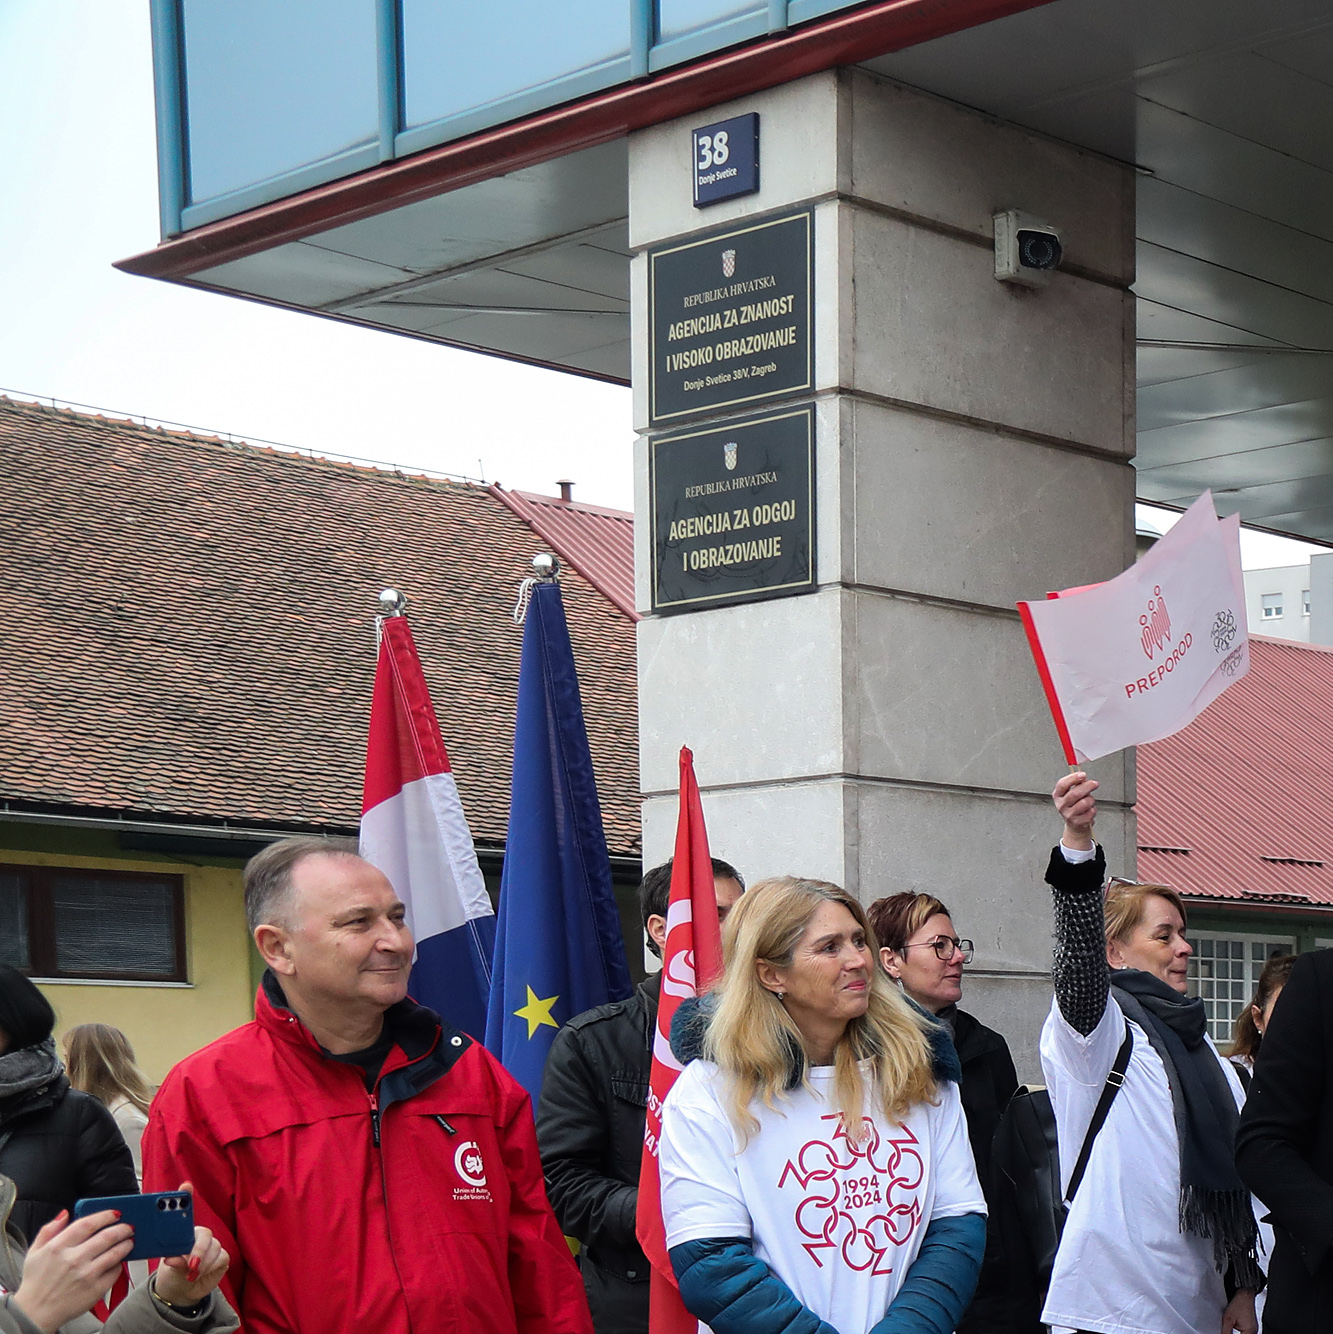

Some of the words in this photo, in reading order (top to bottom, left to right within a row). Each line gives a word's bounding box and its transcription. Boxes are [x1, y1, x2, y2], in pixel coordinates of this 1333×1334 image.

[698, 131, 729, 170] 38
[698, 173, 716, 185] Donje
[716, 168, 737, 180] Svetice
[684, 287, 729, 308] REPUBLIKA
[730, 275, 776, 296] HRVATSKA
[668, 312, 722, 341] AGENCIJA
[724, 309, 739, 328] ZA
[740, 295, 794, 324] ZNANOST
[666, 356, 670, 372] I
[672, 345, 713, 370] VISOKO
[716, 326, 796, 361] OBRAZOVANJE
[684, 378, 704, 391] Donje
[706, 373, 731, 387] Svetice
[732, 369, 750, 380] 38/V,
[751, 362, 777, 376] Zagreb
[685, 480, 731, 498] REPUBLIKA
[732, 471, 777, 490] HRVATSKA
[669, 512, 731, 541] AGENCIJA
[733, 509, 750, 530] ZA
[752, 500, 796, 526] ODGOJ
[683, 552, 687, 571] I
[690, 536, 782, 570] OBRAZOVANJE
[1124, 632, 1193, 699] PREPOROD
[842, 1174, 879, 1194] 1994
[844, 1190, 882, 1210] 2024
